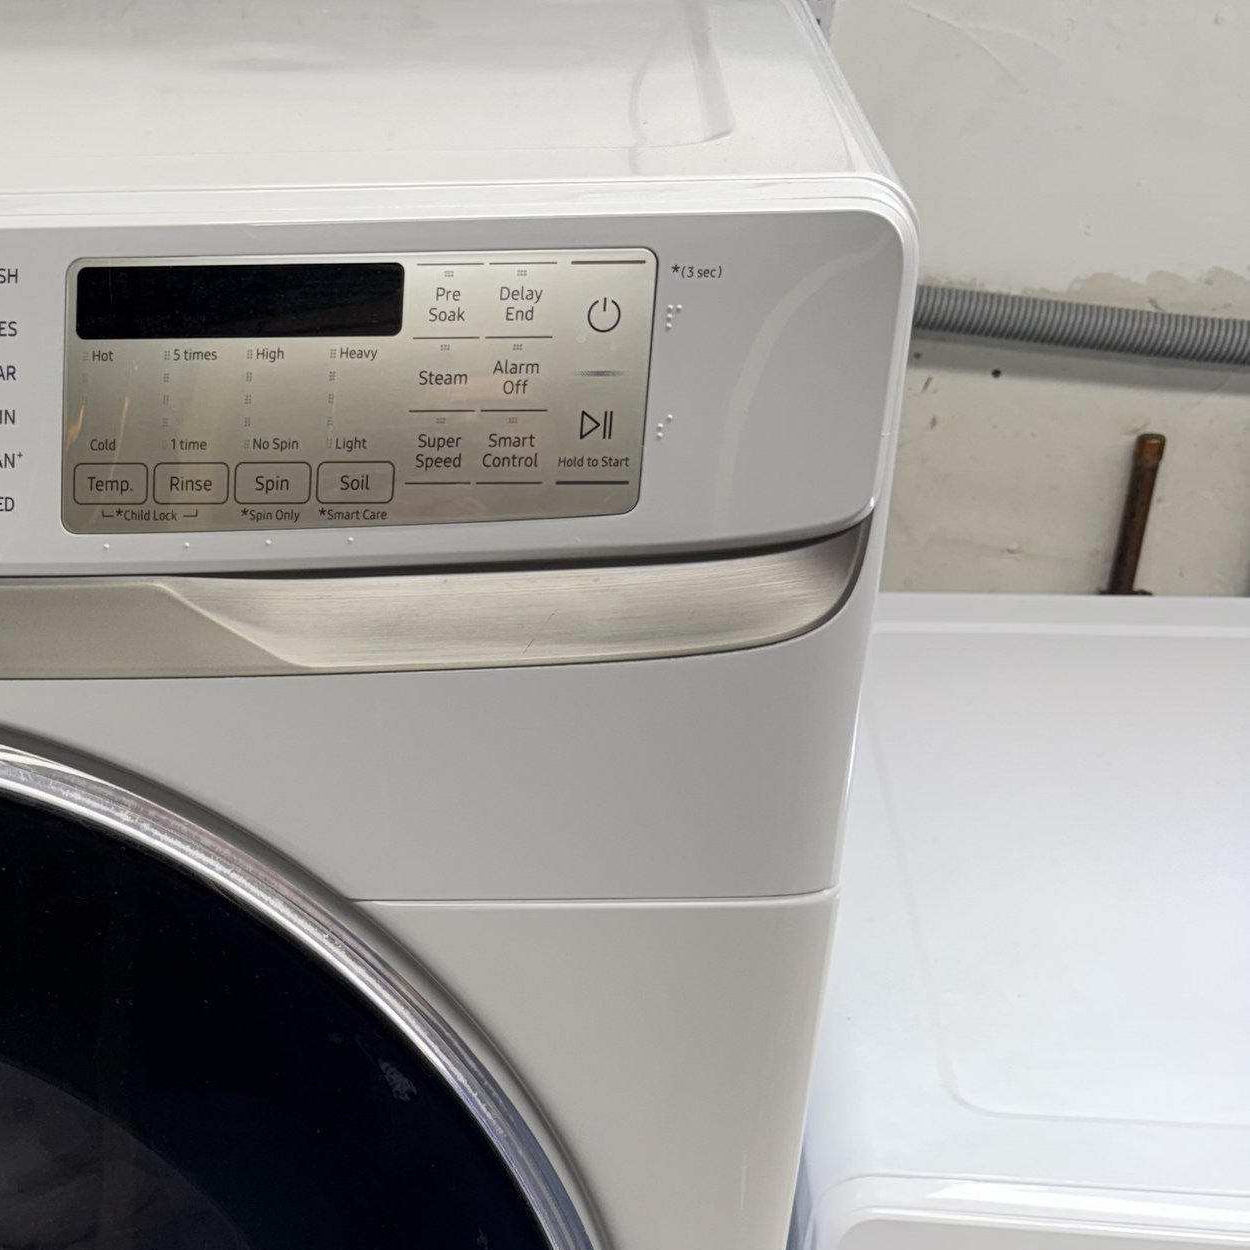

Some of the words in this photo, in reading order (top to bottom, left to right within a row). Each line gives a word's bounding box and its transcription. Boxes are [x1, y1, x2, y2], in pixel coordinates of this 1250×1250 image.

[696, 265, 723, 279] sec)
[435, 286, 461, 302] Pre
[499, 285, 544, 305] Delay
[428, 306, 466, 323] Soak
[505, 305, 535, 322] End
[92, 349, 114, 362] Hot
[173, 348, 181, 362] 5
[182, 348, 218, 361] times
[256, 347, 285, 361] High
[339, 347, 378, 362] Heavy
[492, 359, 540, 375] Alarm
[418, 370, 468, 386] Steam
[502, 378, 529, 395] Off
[89, 438, 117, 452] Cold
[170, 438, 176, 451] 1
[179, 439, 208, 451] time
[252, 437, 270, 451] No
[272, 437, 299, 453] Spin
[335, 436, 367, 453] Light
[417, 433, 462, 452] Super
[488, 432, 536, 448] Smart
[415, 452, 462, 472] Speed
[482, 452, 538, 468] Control
[557, 455, 585, 468] Hold
[586, 456, 599, 468] to
[601, 455, 630, 468] Start
[86, 476, 134, 496] Temp.
[169, 475, 213, 492] Rinse
[254, 475, 290, 495] Spin
[339, 474, 370, 491] Soil
[153, 509, 178, 522] Lock
[274, 508, 301, 524] Only
[362, 508, 388, 521] Care
